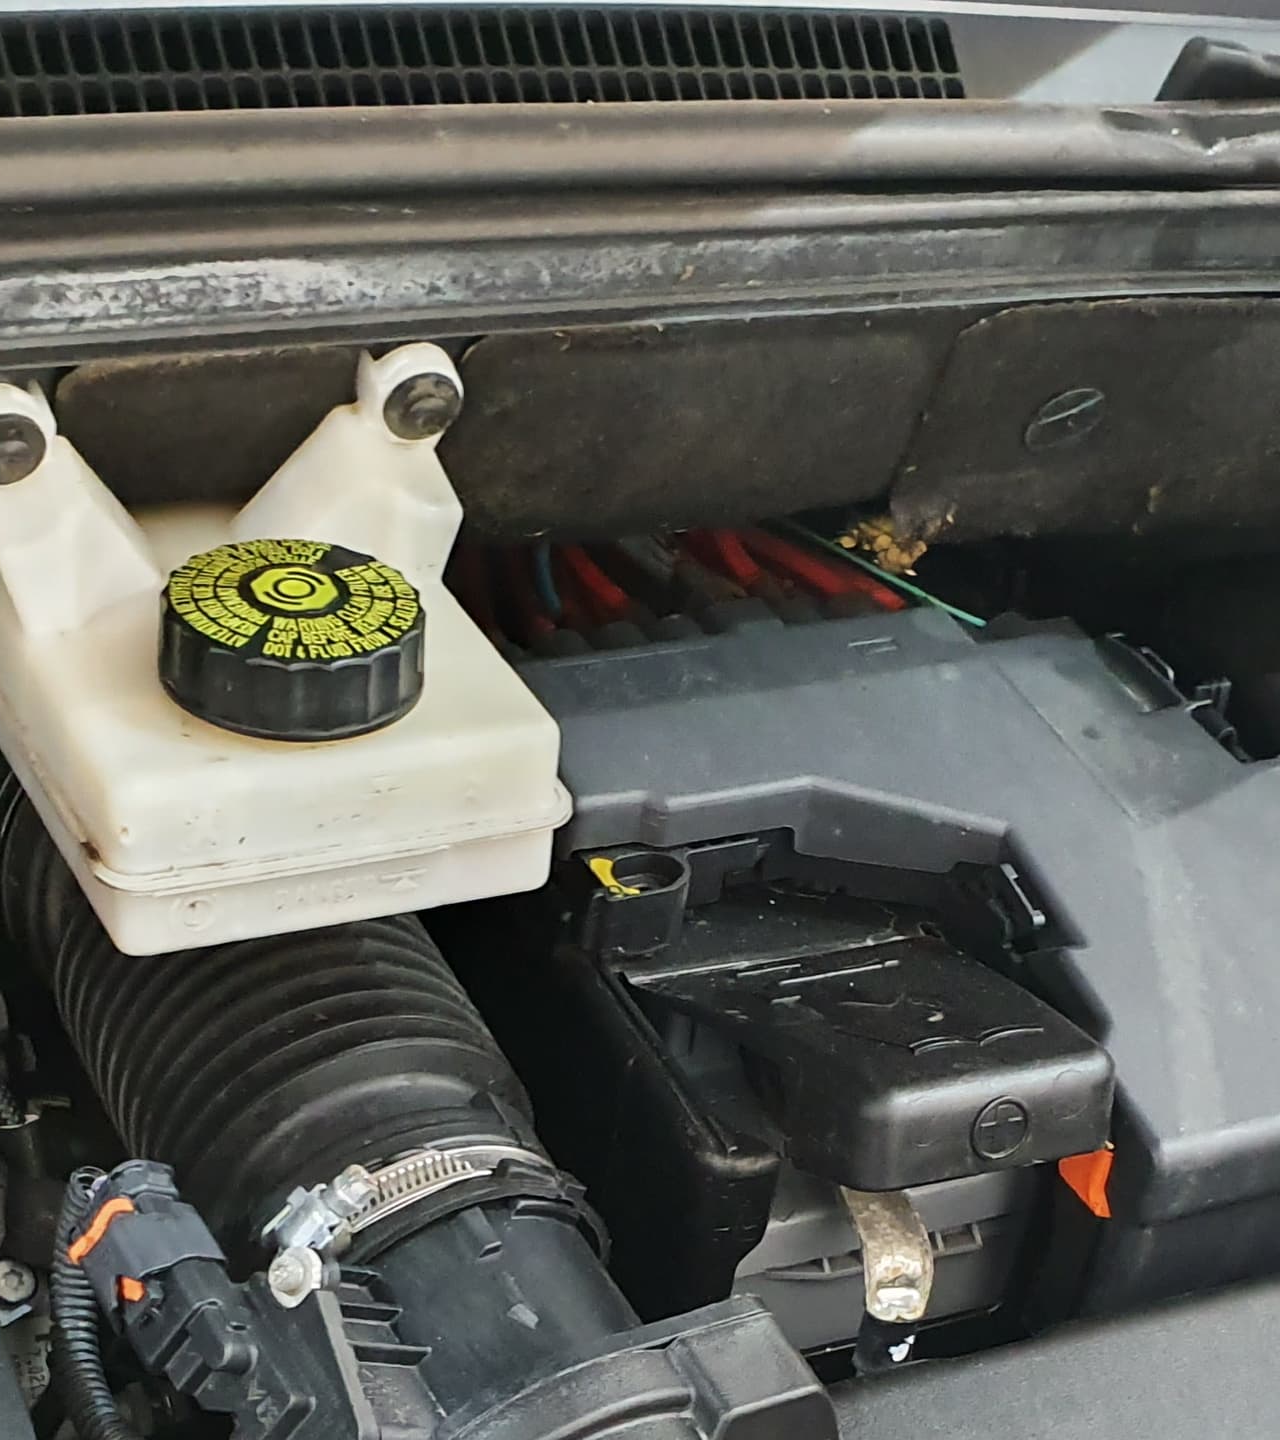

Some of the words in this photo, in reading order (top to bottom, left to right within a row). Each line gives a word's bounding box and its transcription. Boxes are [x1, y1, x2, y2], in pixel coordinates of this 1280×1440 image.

[268, 630, 298, 643] CAP
[262, 642, 293, 658] DOT
[309, 642, 353, 658] FLUID
